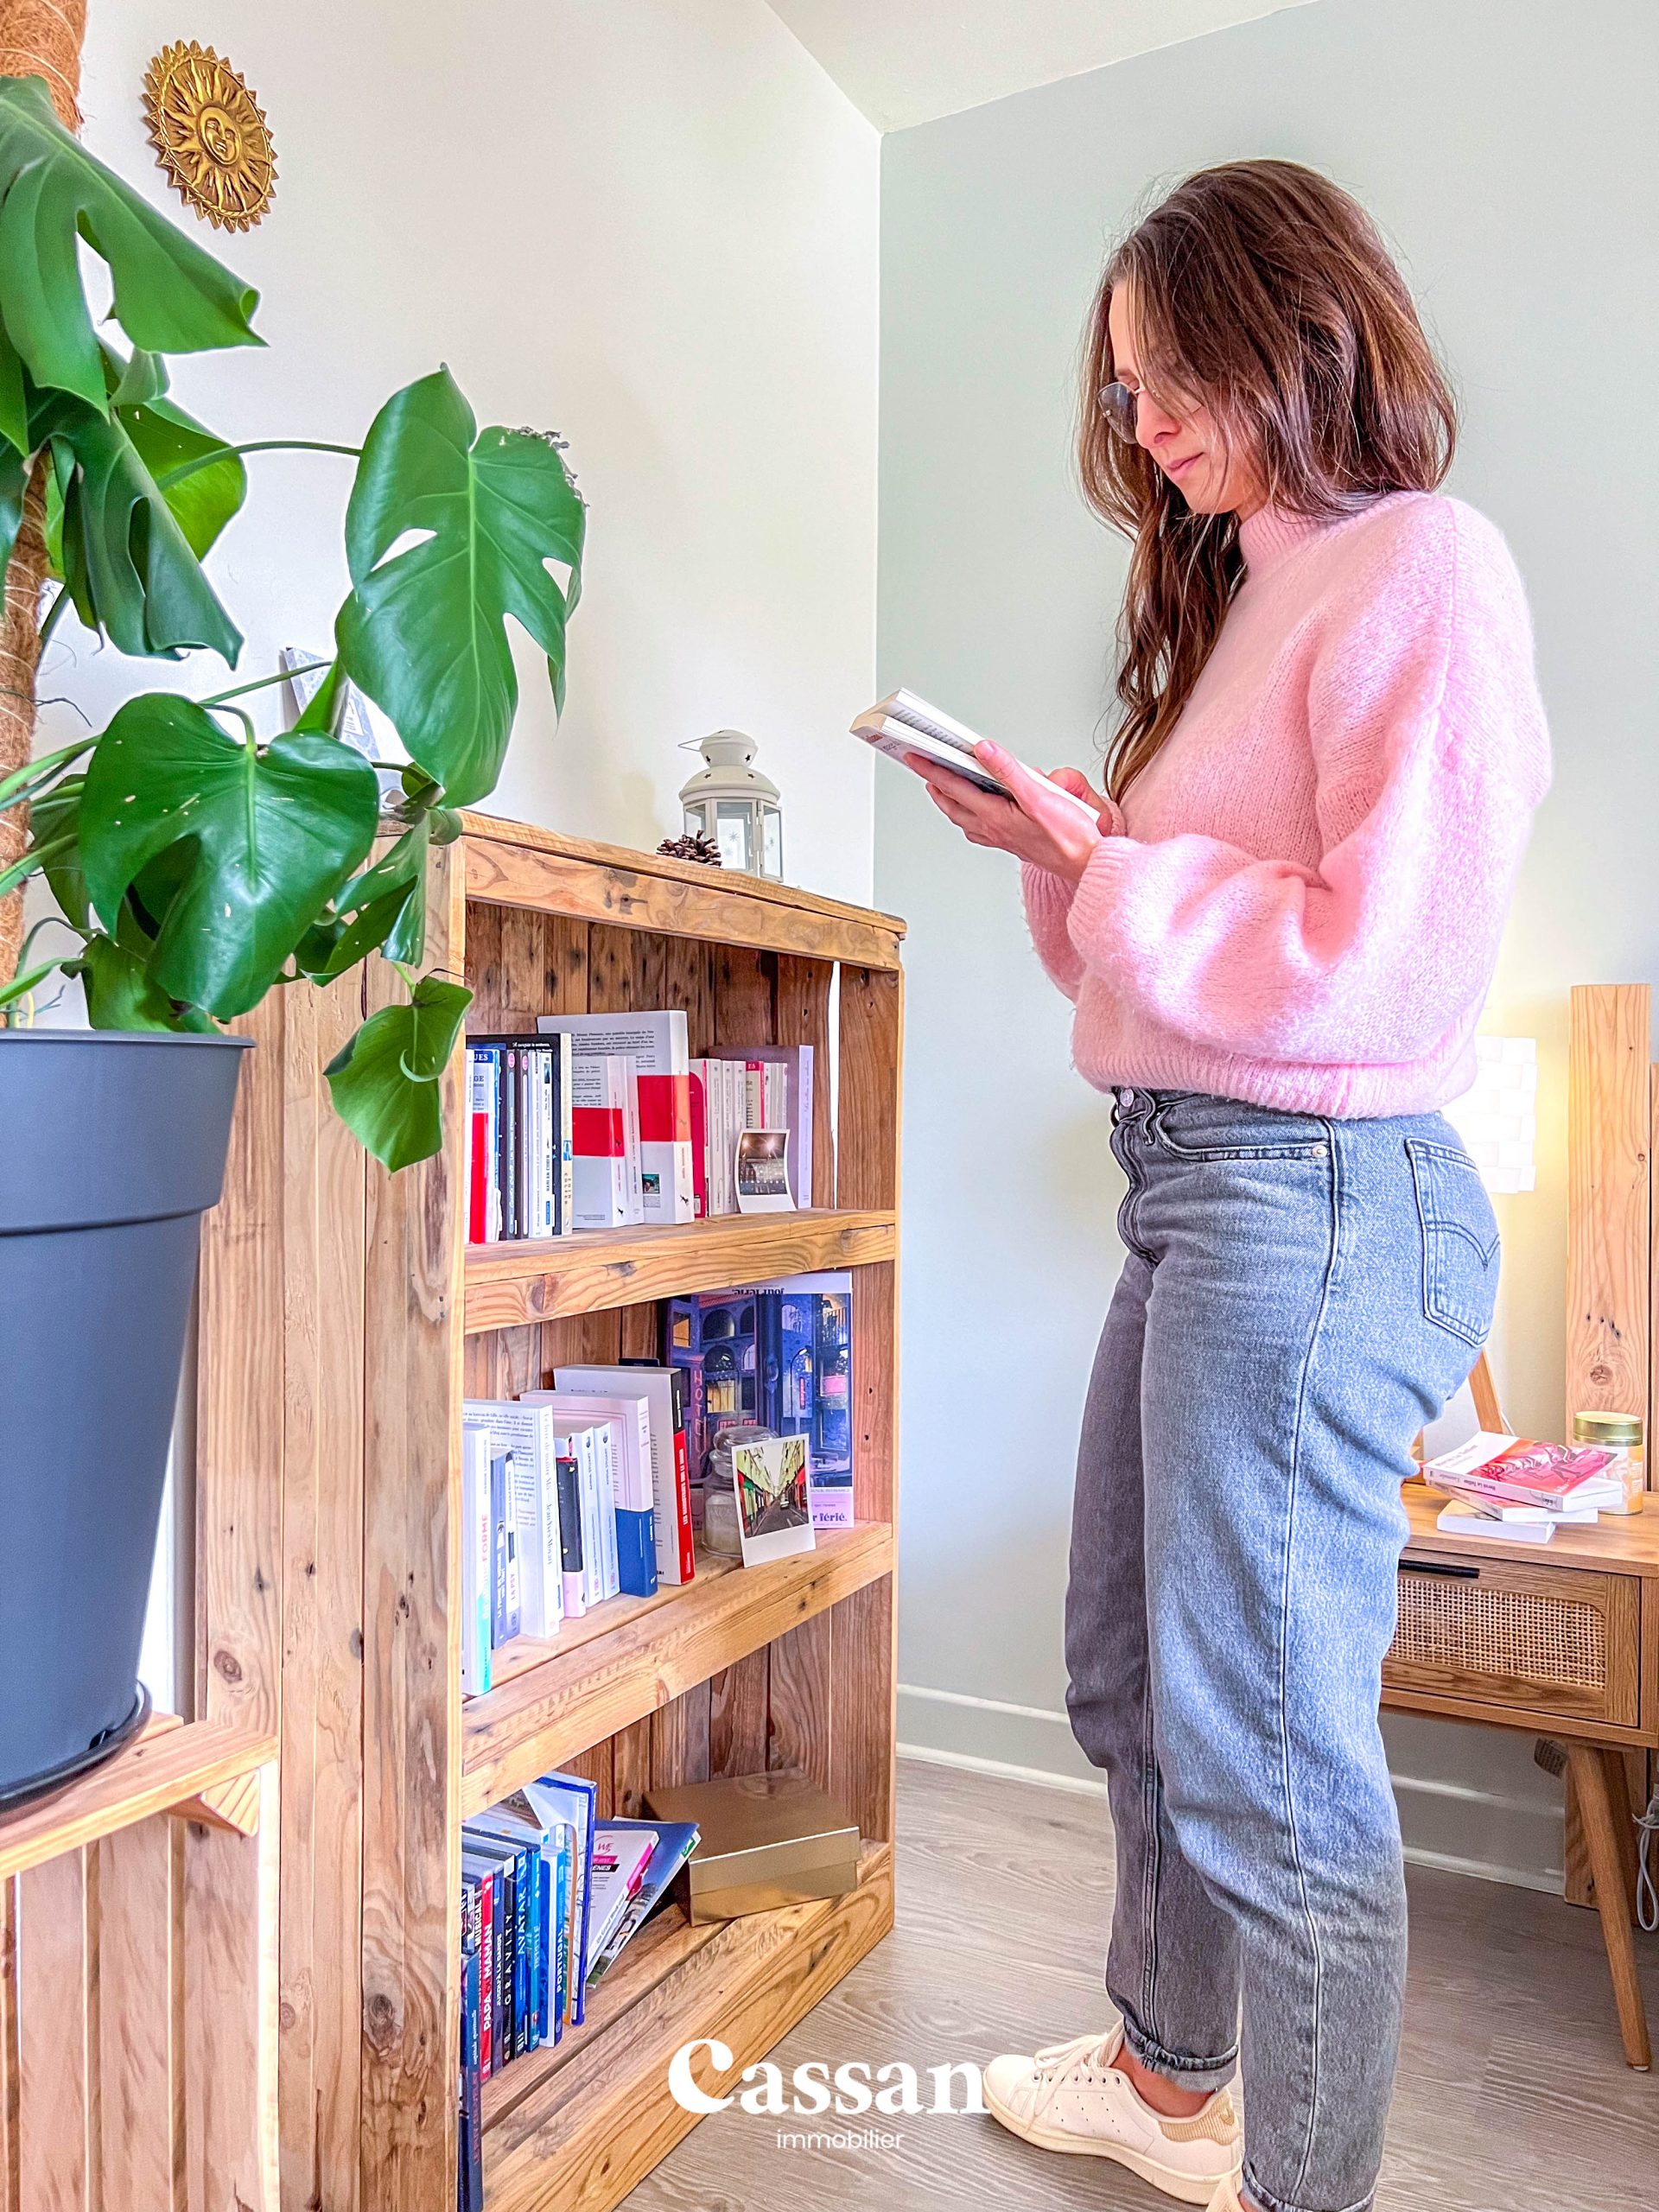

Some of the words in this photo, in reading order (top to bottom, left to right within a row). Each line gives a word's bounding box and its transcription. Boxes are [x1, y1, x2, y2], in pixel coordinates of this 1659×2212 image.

[518, 1887, 527, 1955] AVATAR
[484, 1923, 493, 1979] MAMAN
[496, 1961, 503, 1972] LA
[483, 1993, 492, 2031] PAPA
